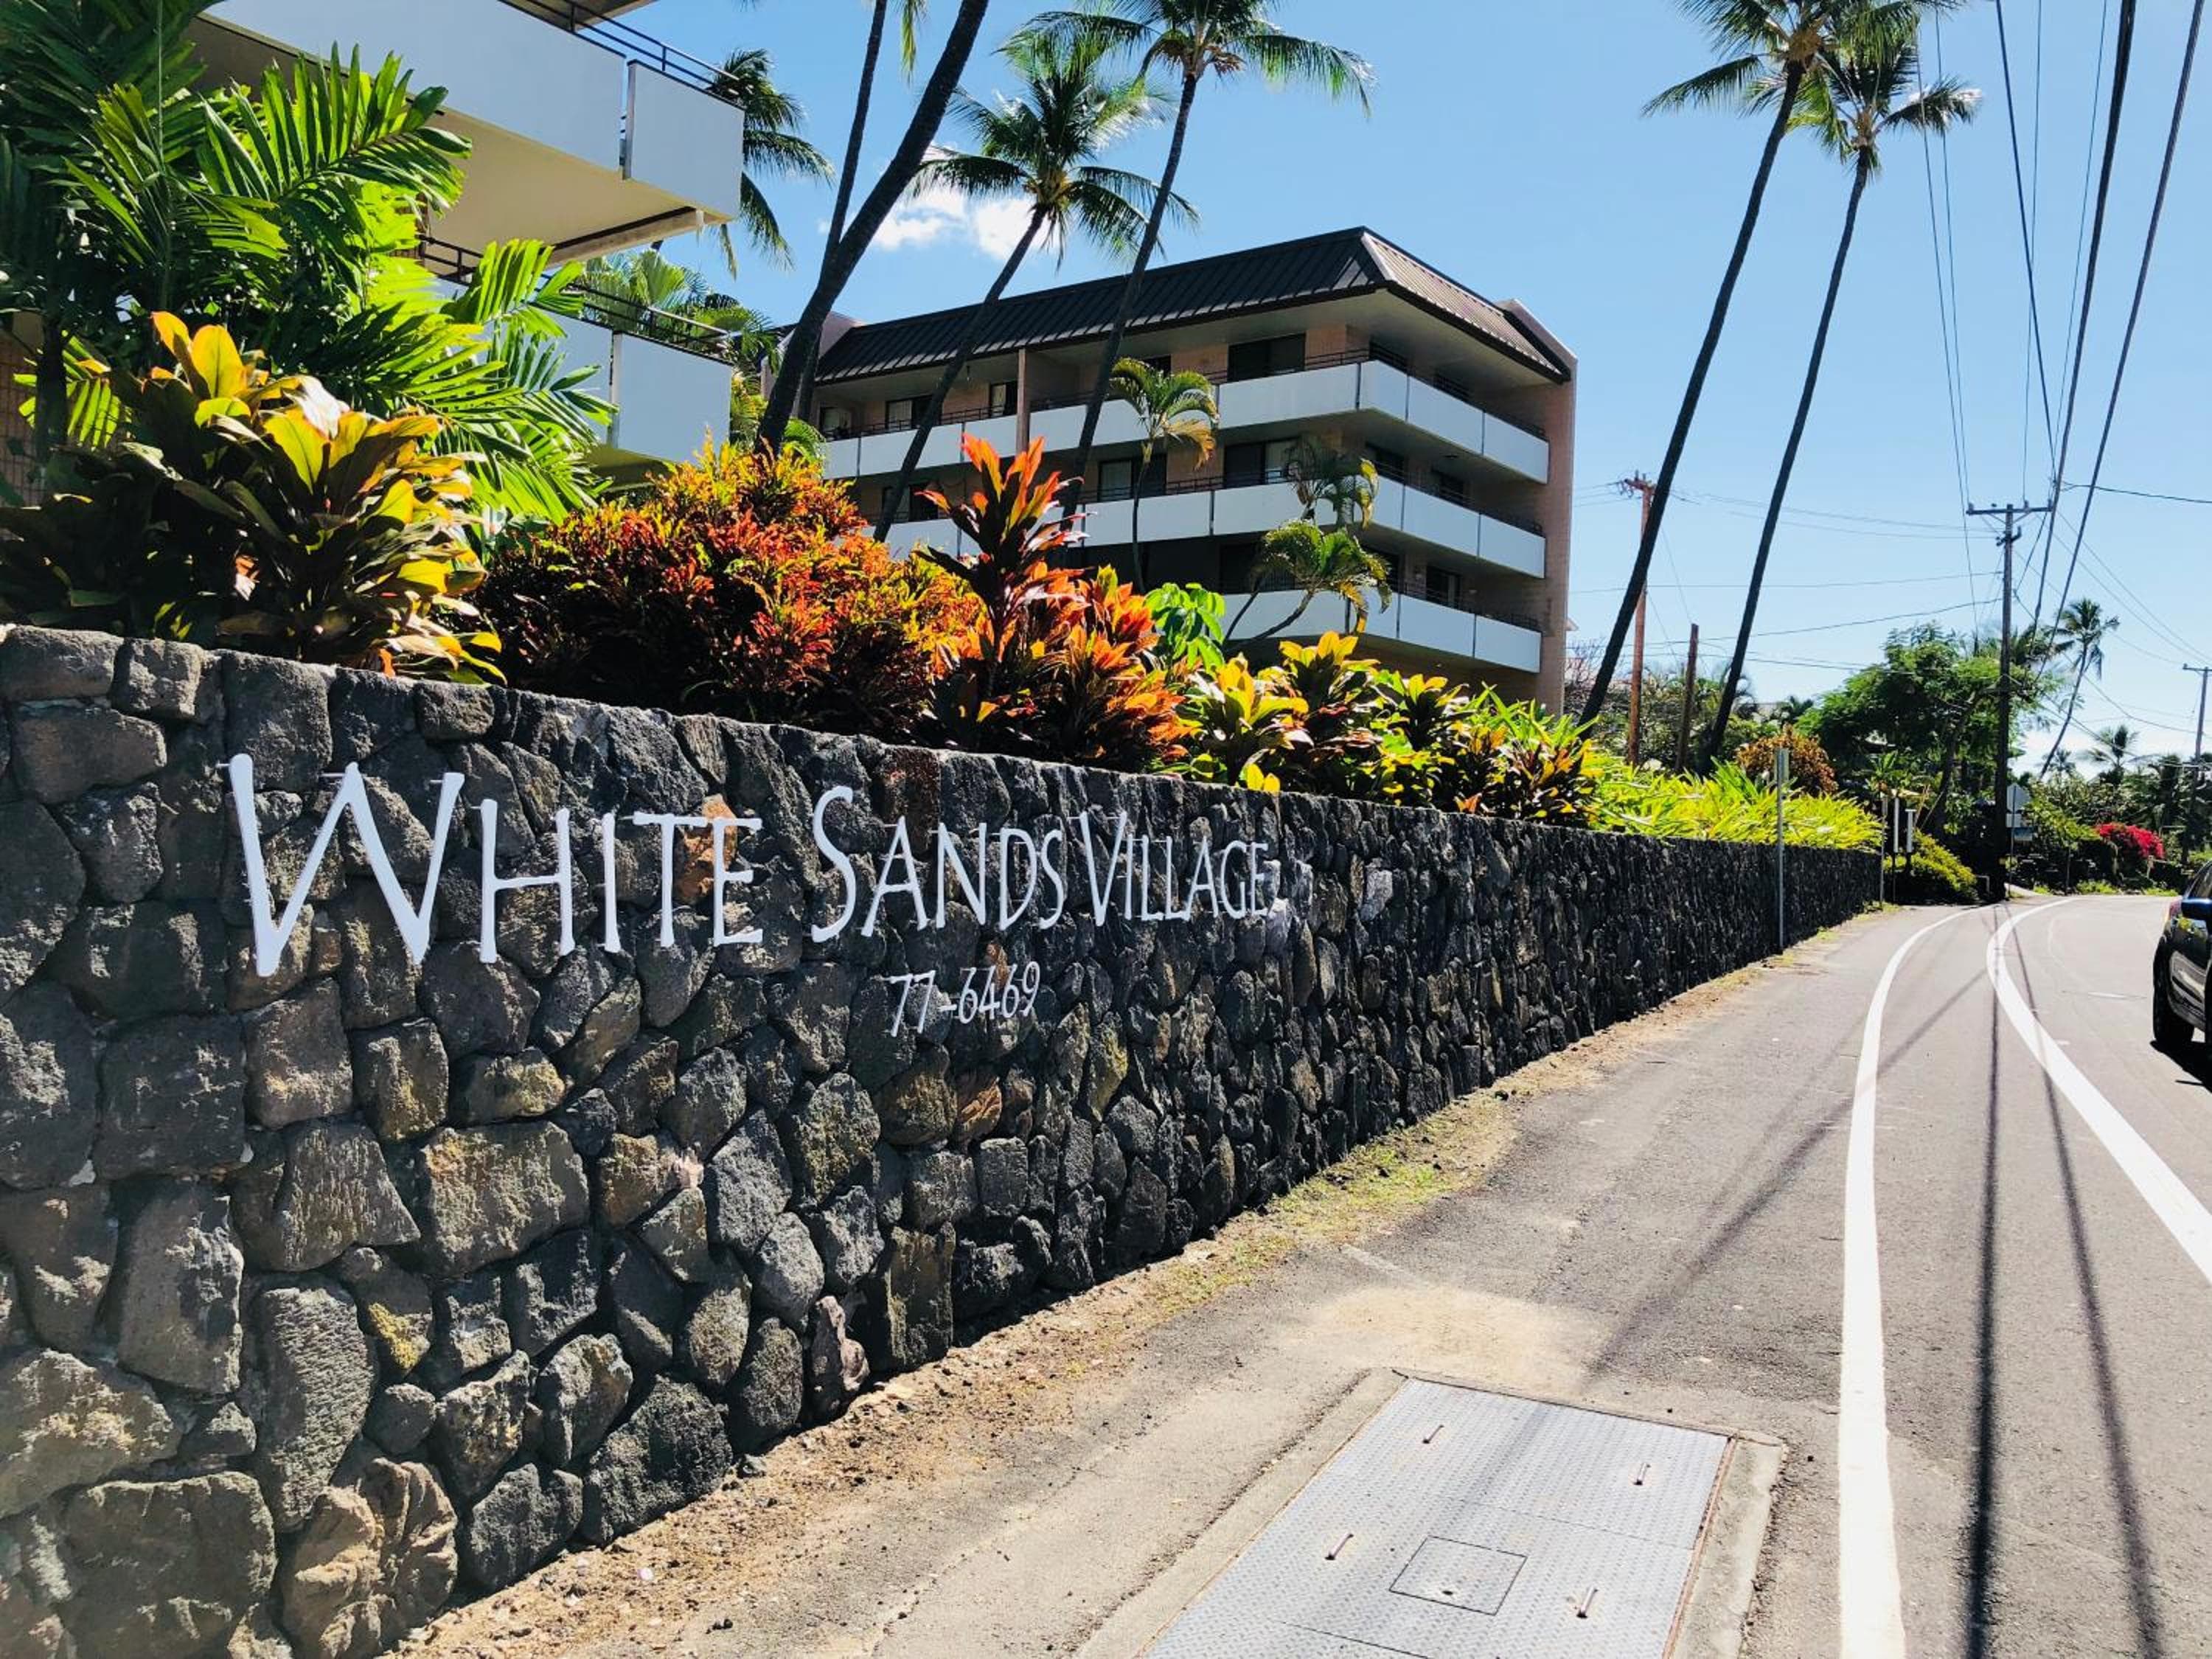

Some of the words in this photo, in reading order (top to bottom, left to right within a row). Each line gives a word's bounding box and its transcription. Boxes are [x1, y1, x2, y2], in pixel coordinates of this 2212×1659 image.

[229, 753, 763, 977] WHITE
[811, 785, 1065, 943] SANDS
[1079, 811, 1269, 927] VILLAGE
[888, 961, 1041, 1037] 77-6469
